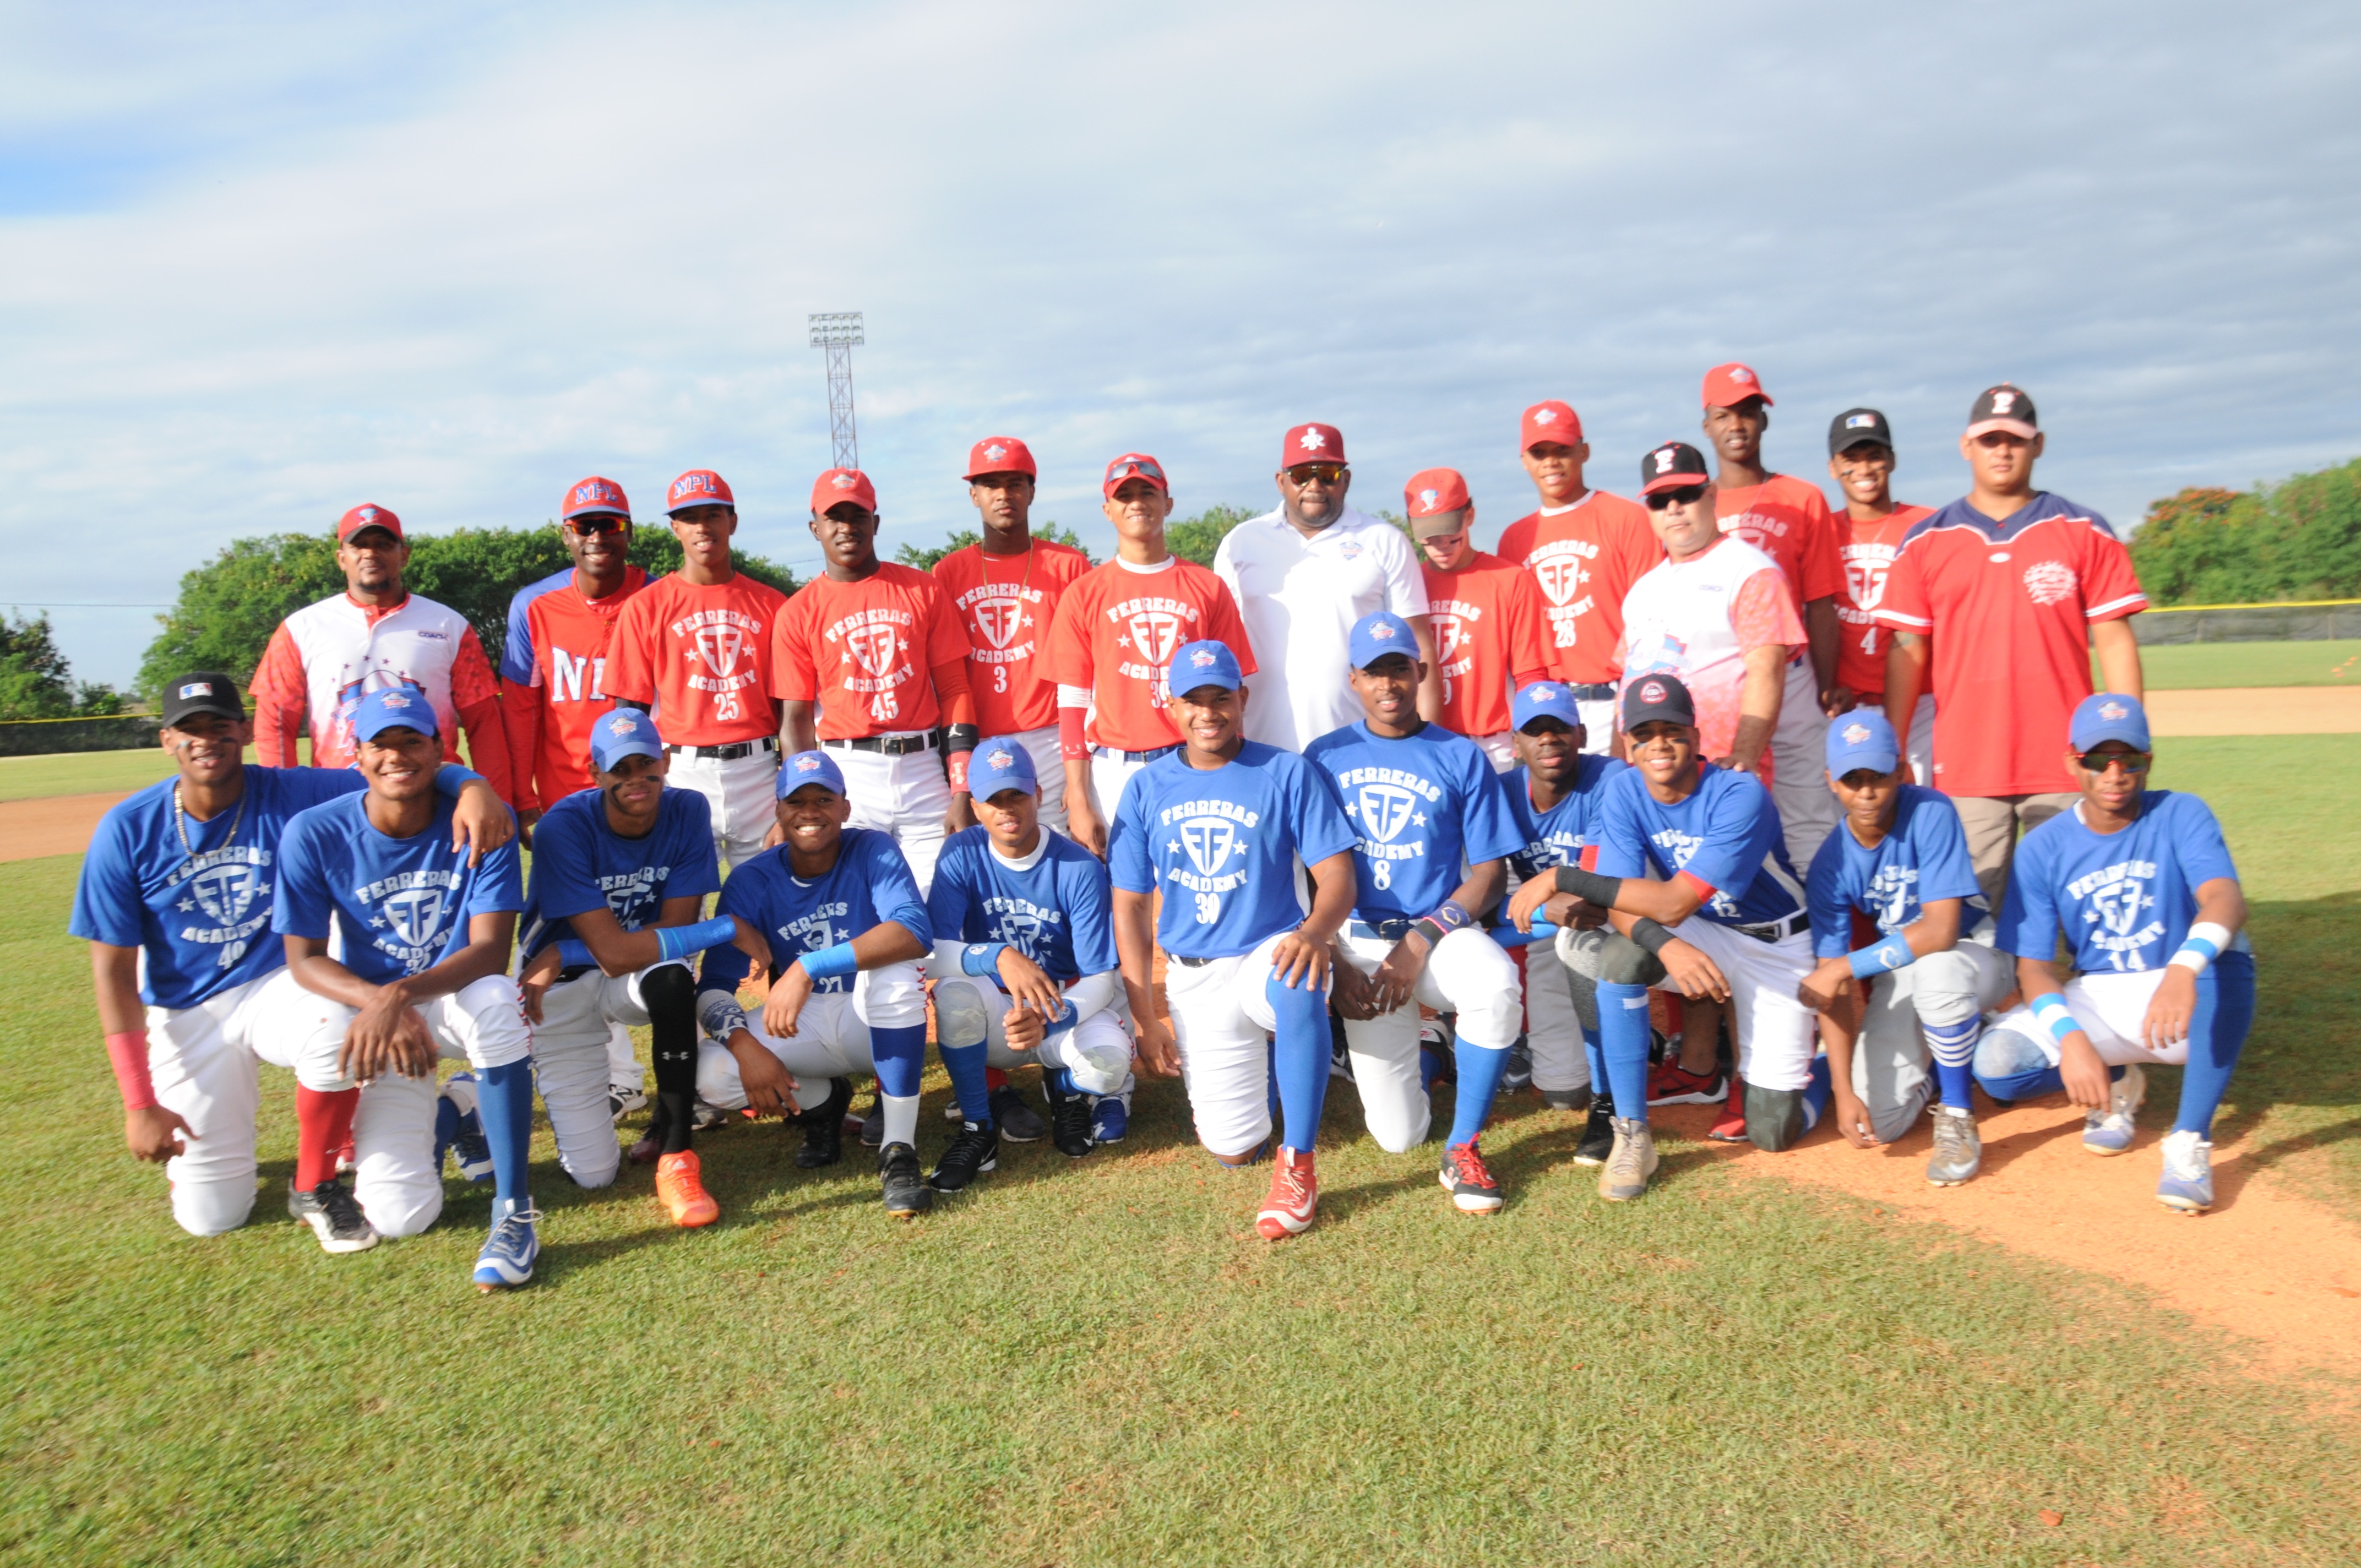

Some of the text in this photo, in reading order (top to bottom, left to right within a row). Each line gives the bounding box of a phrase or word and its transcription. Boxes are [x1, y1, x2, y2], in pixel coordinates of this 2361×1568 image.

[575, 482, 617, 504] NPL
[674, 475, 716, 499] NPL
[956, 583, 1042, 611] FERRERAS
[1106, 597, 1199, 623] FERRERAS
[1428, 599, 1482, 622] RERAS
[671, 609, 761, 638] FERRERAS
[825, 608, 912, 643] FERRERAS
[1553, 619, 1576, 648] 28
[1860, 627, 1877, 655] 4
[688, 669, 757, 692] ACADEMY
[844, 663, 914, 692] ACADEMY
[993, 665, 1008, 694] 3
[1118, 661, 1169, 680] ACADE
[714, 692, 739, 721] 25
[871, 691, 899, 721] 45
[1339, 767, 1441, 802] FERRERAS
[1160, 800, 1259, 828] FERRERAS
[1353, 836, 1424, 860] CADEMY
[355, 870, 462, 905] FERRERAS
[1167, 867, 1248, 892] ACADEMY
[1373, 859, 1391, 891] 8
[1195, 892, 1220, 924] 30
[1710, 902, 1742, 918] 12
[217, 940, 247, 970] 40
[2108, 950, 2147, 972] 14
[819, 976, 844, 994] 27
